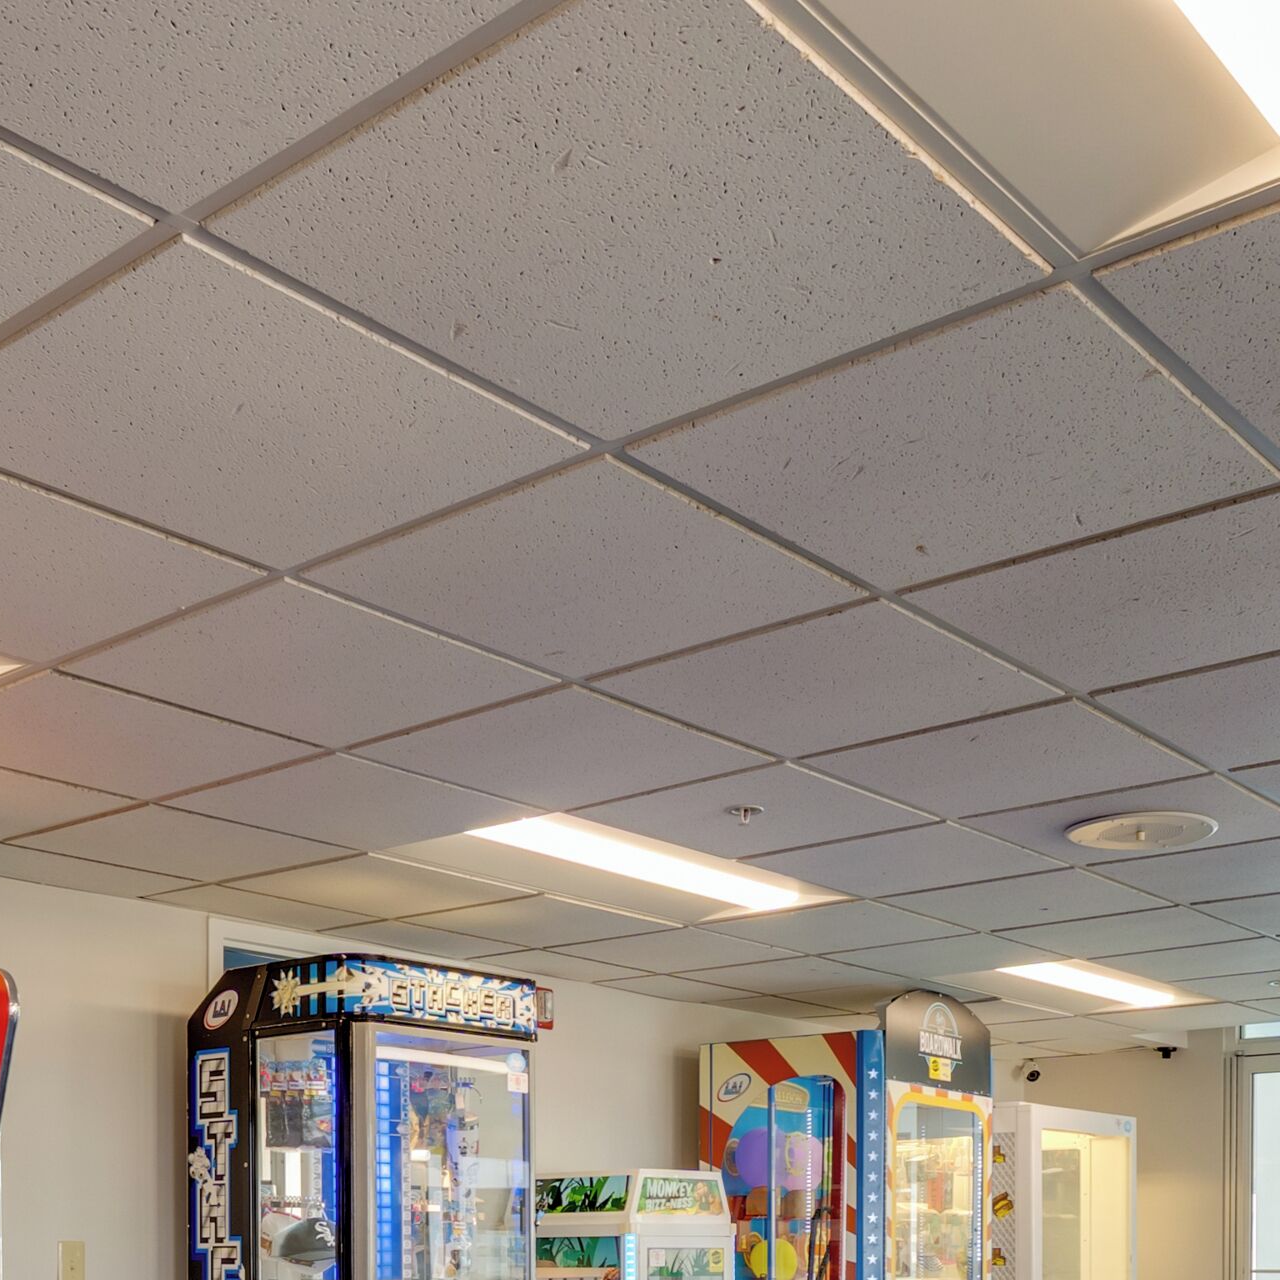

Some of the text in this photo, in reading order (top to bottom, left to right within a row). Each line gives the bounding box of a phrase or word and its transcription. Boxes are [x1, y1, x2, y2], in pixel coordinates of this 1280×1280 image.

[391, 976, 514, 1021] STACKER
[919, 1030, 962, 1060] BOARDWALK
[646, 1179, 693, 1198] MONKEY
